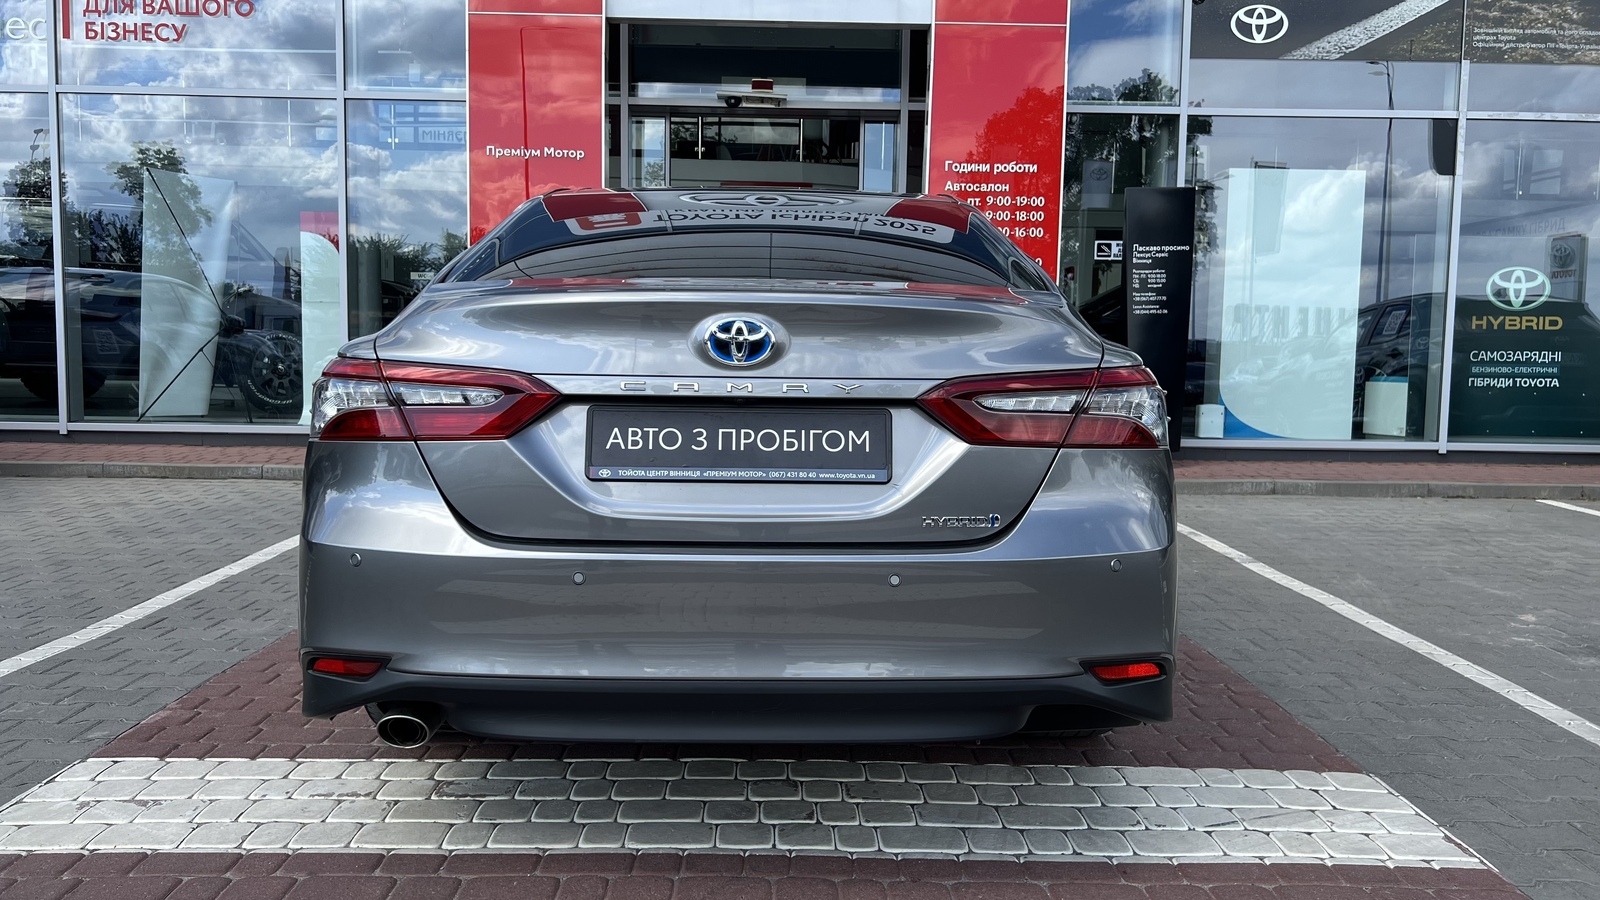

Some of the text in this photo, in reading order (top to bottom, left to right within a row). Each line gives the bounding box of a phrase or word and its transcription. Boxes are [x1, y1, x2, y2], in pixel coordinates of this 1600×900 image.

[83, 0, 255, 17] ДЛЯ ВАШОГО
[84, 21, 187, 42] БІЗНЕСУ
[486, 146, 585, 161] Преміум Мотор
[944, 161, 1038, 175] Години роботи
[944, 181, 1010, 192] Автосалон
[986, 196, 1045, 207] 9:00-19:00
[986, 210, 1045, 222] 9:00-18:00
[1132, 244, 1161, 252] Ласкаво
[1471, 315, 1564, 331] HYBRID
[1469, 350, 1562, 364] САМОЗАРЯДНІ
[1471, 366, 1558, 374] БЕНЗИНОВО-ЕЛЕКТРИЧНІ
[619, 380, 863, 394] CAMRY
[1468, 377, 1560, 388] ГІБРИДИ TOYOTA
[605, 427, 682, 451] АВТО
[718, 427, 871, 453] ПРОБІГОМ
[618, 467, 646, 477] ТОЙОТА
[646, 469, 669, 478] ЦЕНТР
[669, 469, 701, 478] ВІННИЦЯ
[702, 470, 737, 478] «ПРЕМІУМ
[738, 470, 767, 478] МОТОР»
[768, 471, 786, 479] (067)
[798, 471, 808, 479] 80
[808, 471, 817, 479] 40
[818, 472, 876, 480] www.toyota.vn.ua
[921, 515, 989, 528] HYBRID
